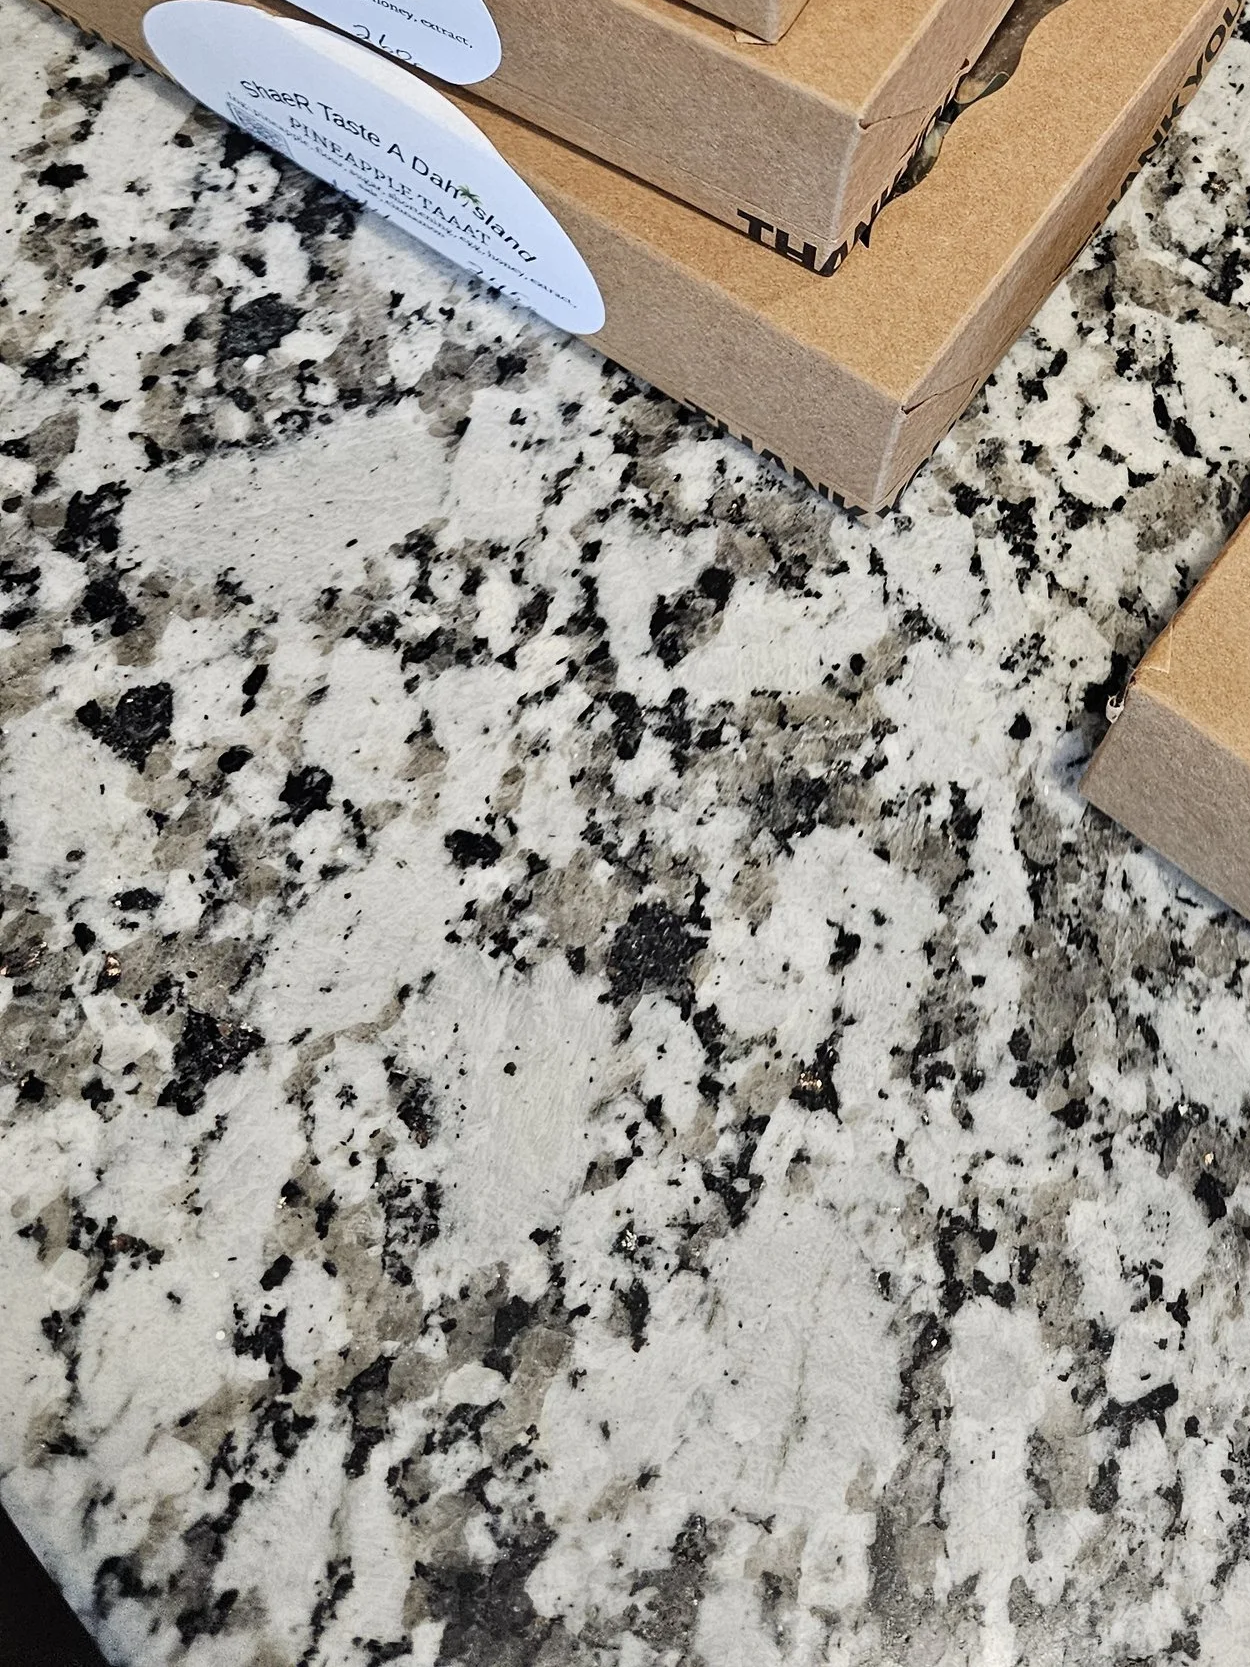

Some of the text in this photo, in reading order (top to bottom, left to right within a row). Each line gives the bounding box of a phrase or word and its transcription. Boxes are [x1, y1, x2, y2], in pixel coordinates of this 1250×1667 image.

[420, 17, 474, 49] extract,
[289, 115, 417, 202] PINEAPPLE
[417, 194, 492, 246] TAAAT
[317, 102, 380, 147] Taste
[387, 143, 405, 163] A
[411, 155, 461, 200] Dah
